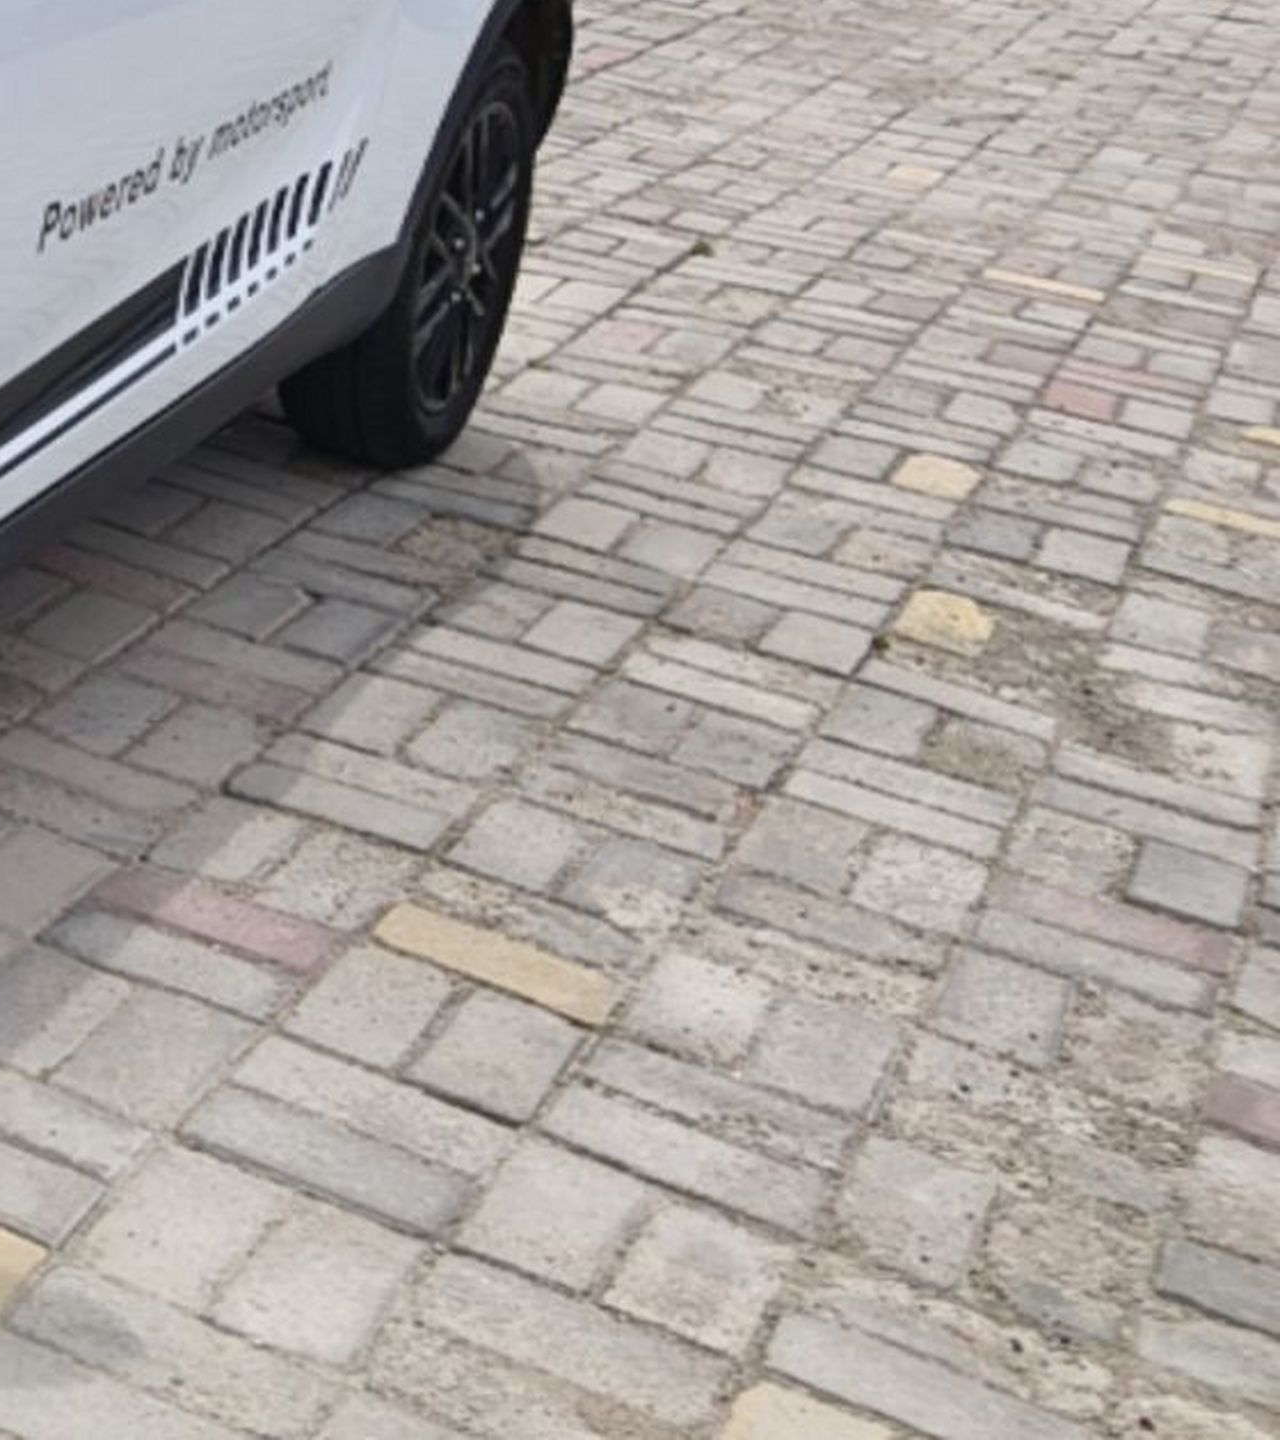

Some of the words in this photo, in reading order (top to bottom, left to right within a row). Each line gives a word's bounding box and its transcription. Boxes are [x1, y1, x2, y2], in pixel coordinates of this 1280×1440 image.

[37, 147, 165, 254] Powered
[170, 136, 205, 184] by
[207, 60, 332, 159] motorsport
